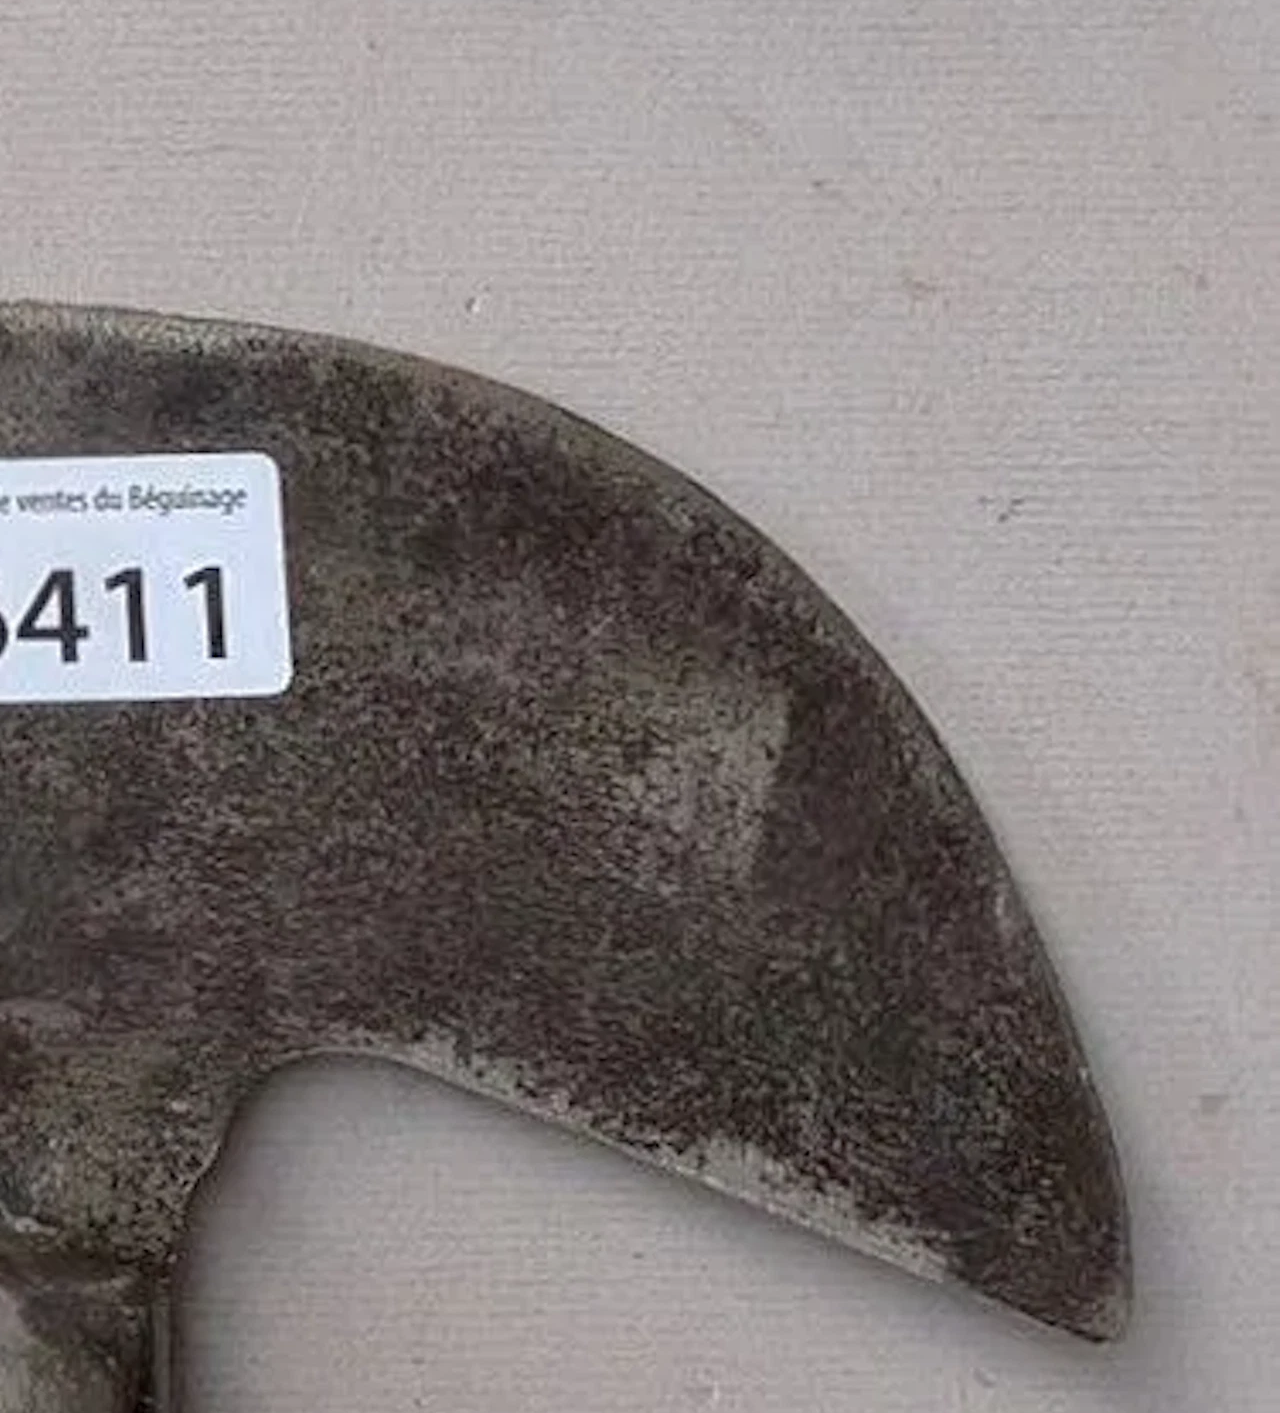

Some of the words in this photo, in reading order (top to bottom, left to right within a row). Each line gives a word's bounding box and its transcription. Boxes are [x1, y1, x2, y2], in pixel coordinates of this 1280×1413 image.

[16, 489, 88, 514] ventes
[94, 487, 122, 512] du
[128, 484, 248, 516] Béguinage
